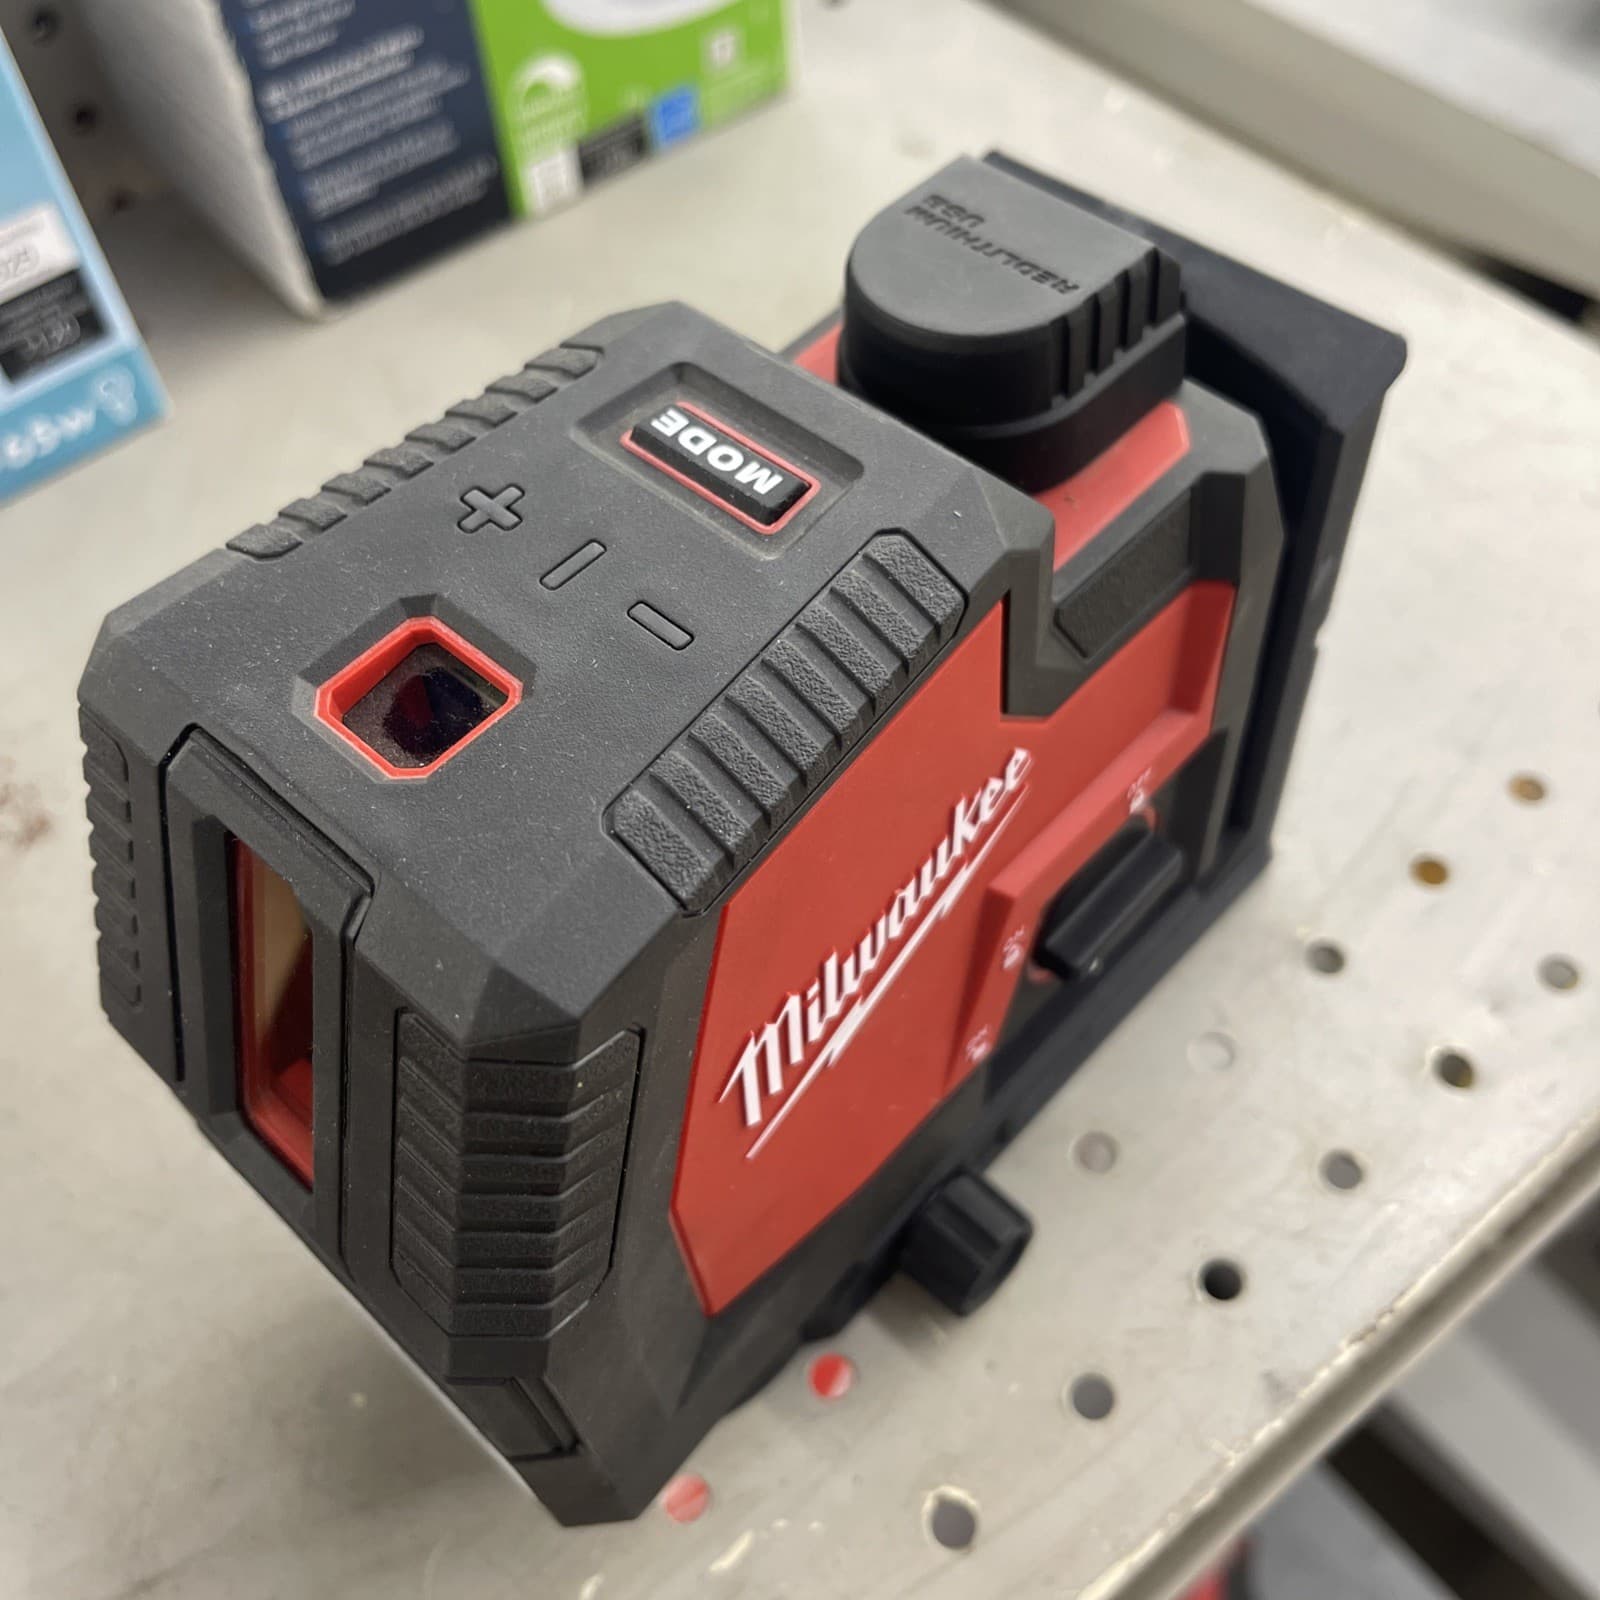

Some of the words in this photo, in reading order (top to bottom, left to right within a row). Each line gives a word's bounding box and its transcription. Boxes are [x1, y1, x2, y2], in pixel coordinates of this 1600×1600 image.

[904, 205, 1080, 294] REDLITHIUM
[924, 194, 985, 228] USB
[651, 408, 783, 495] MODE
[718, 747, 1031, 1127] Milwaukee
